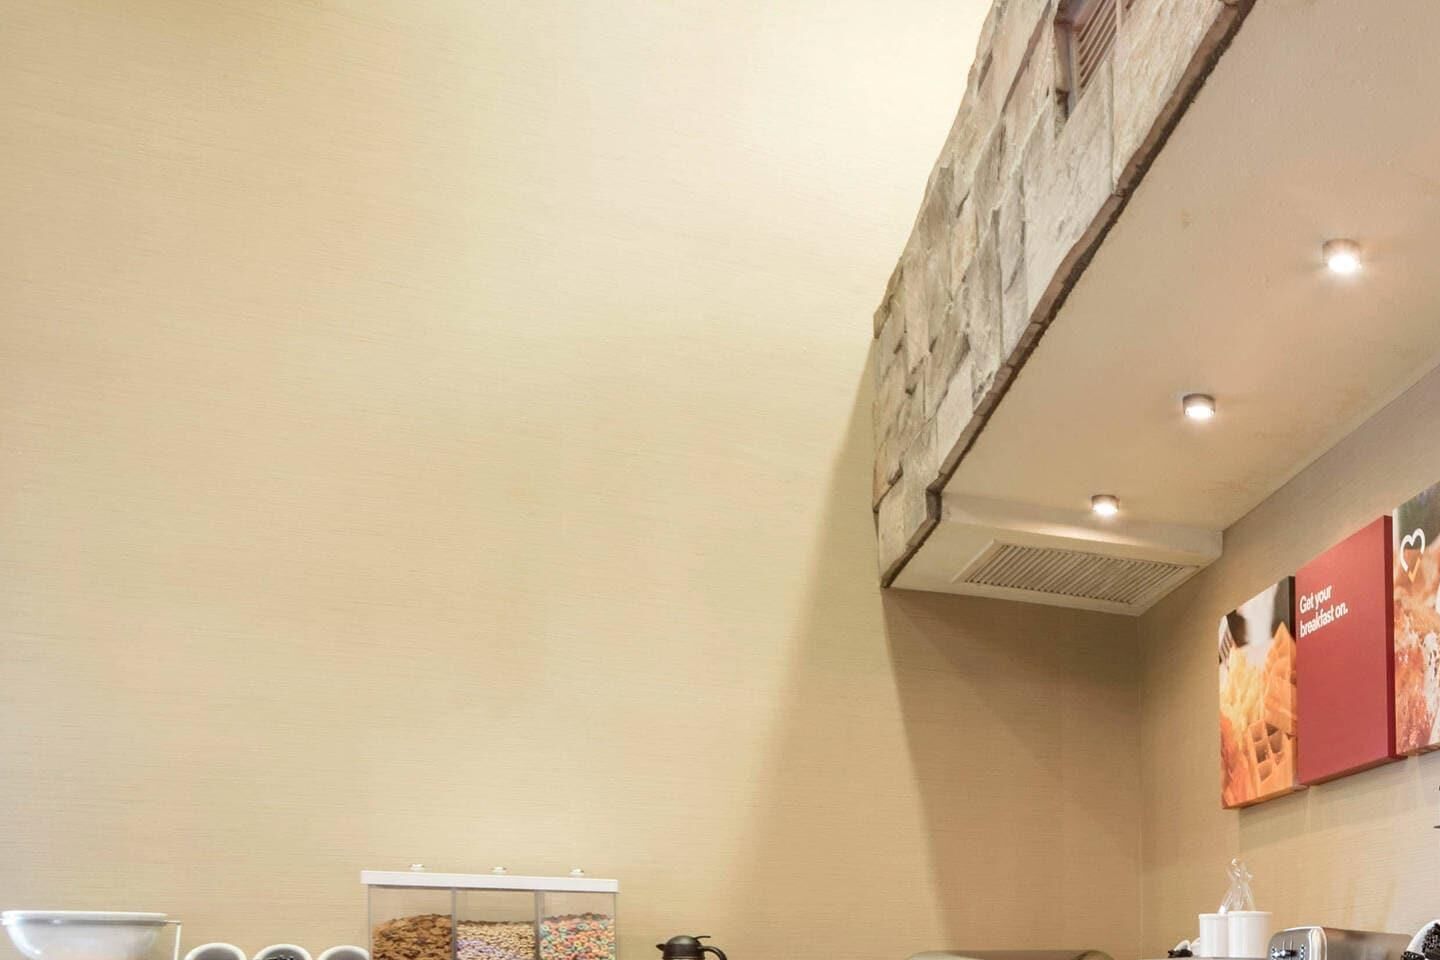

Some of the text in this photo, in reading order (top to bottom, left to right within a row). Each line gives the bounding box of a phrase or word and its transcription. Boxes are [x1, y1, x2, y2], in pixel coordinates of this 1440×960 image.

[1300, 584, 1333, 615] Get your
[1300, 601, 1349, 638] breakfast on.
